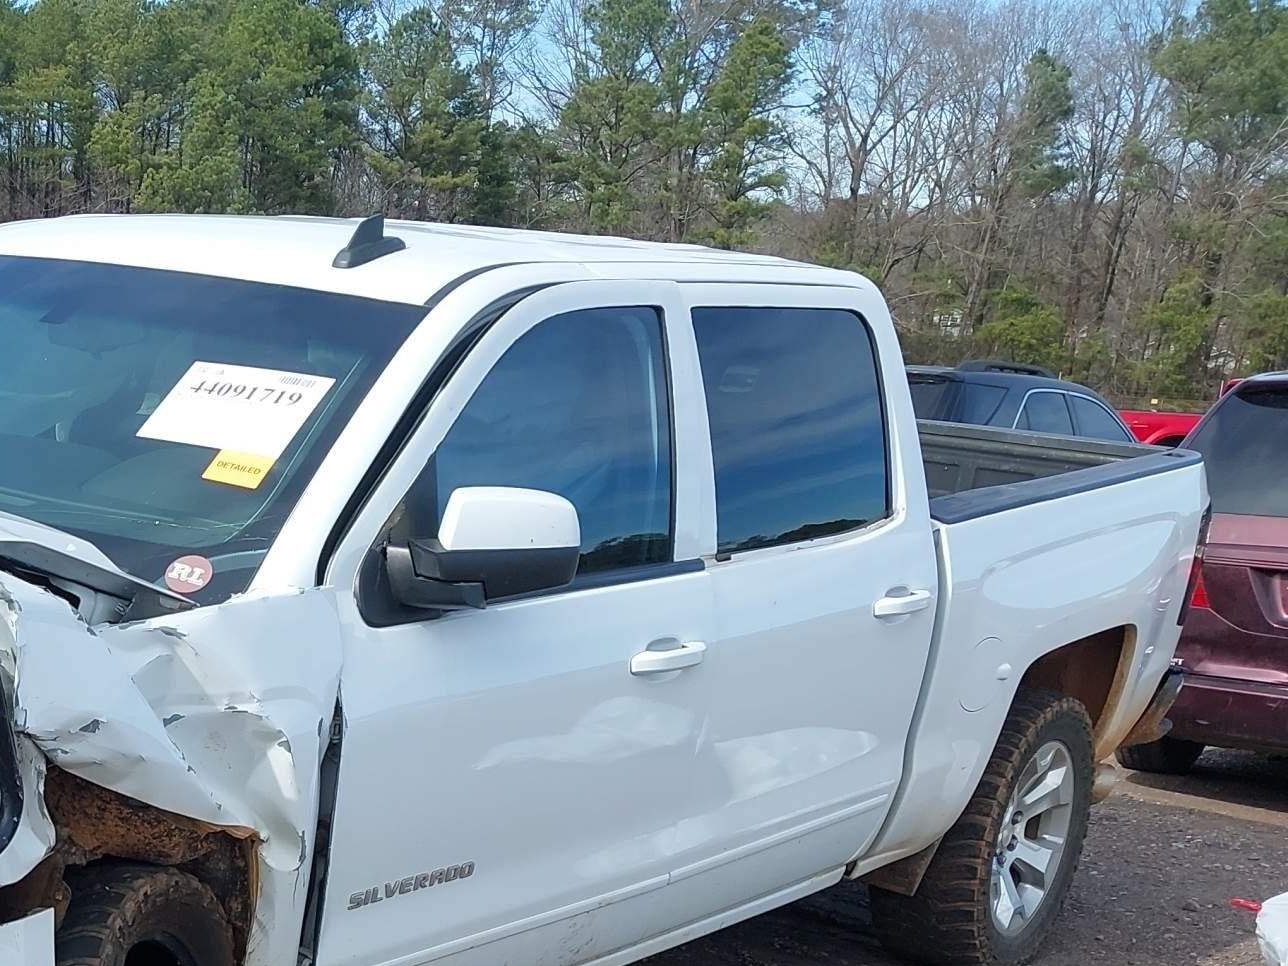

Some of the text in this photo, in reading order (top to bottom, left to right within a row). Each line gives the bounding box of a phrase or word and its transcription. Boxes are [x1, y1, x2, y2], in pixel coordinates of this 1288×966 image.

[190, 380, 303, 406] 44091719
[216, 460, 262, 475] DETAILED
[347, 860, 476, 911] SILVERADO
